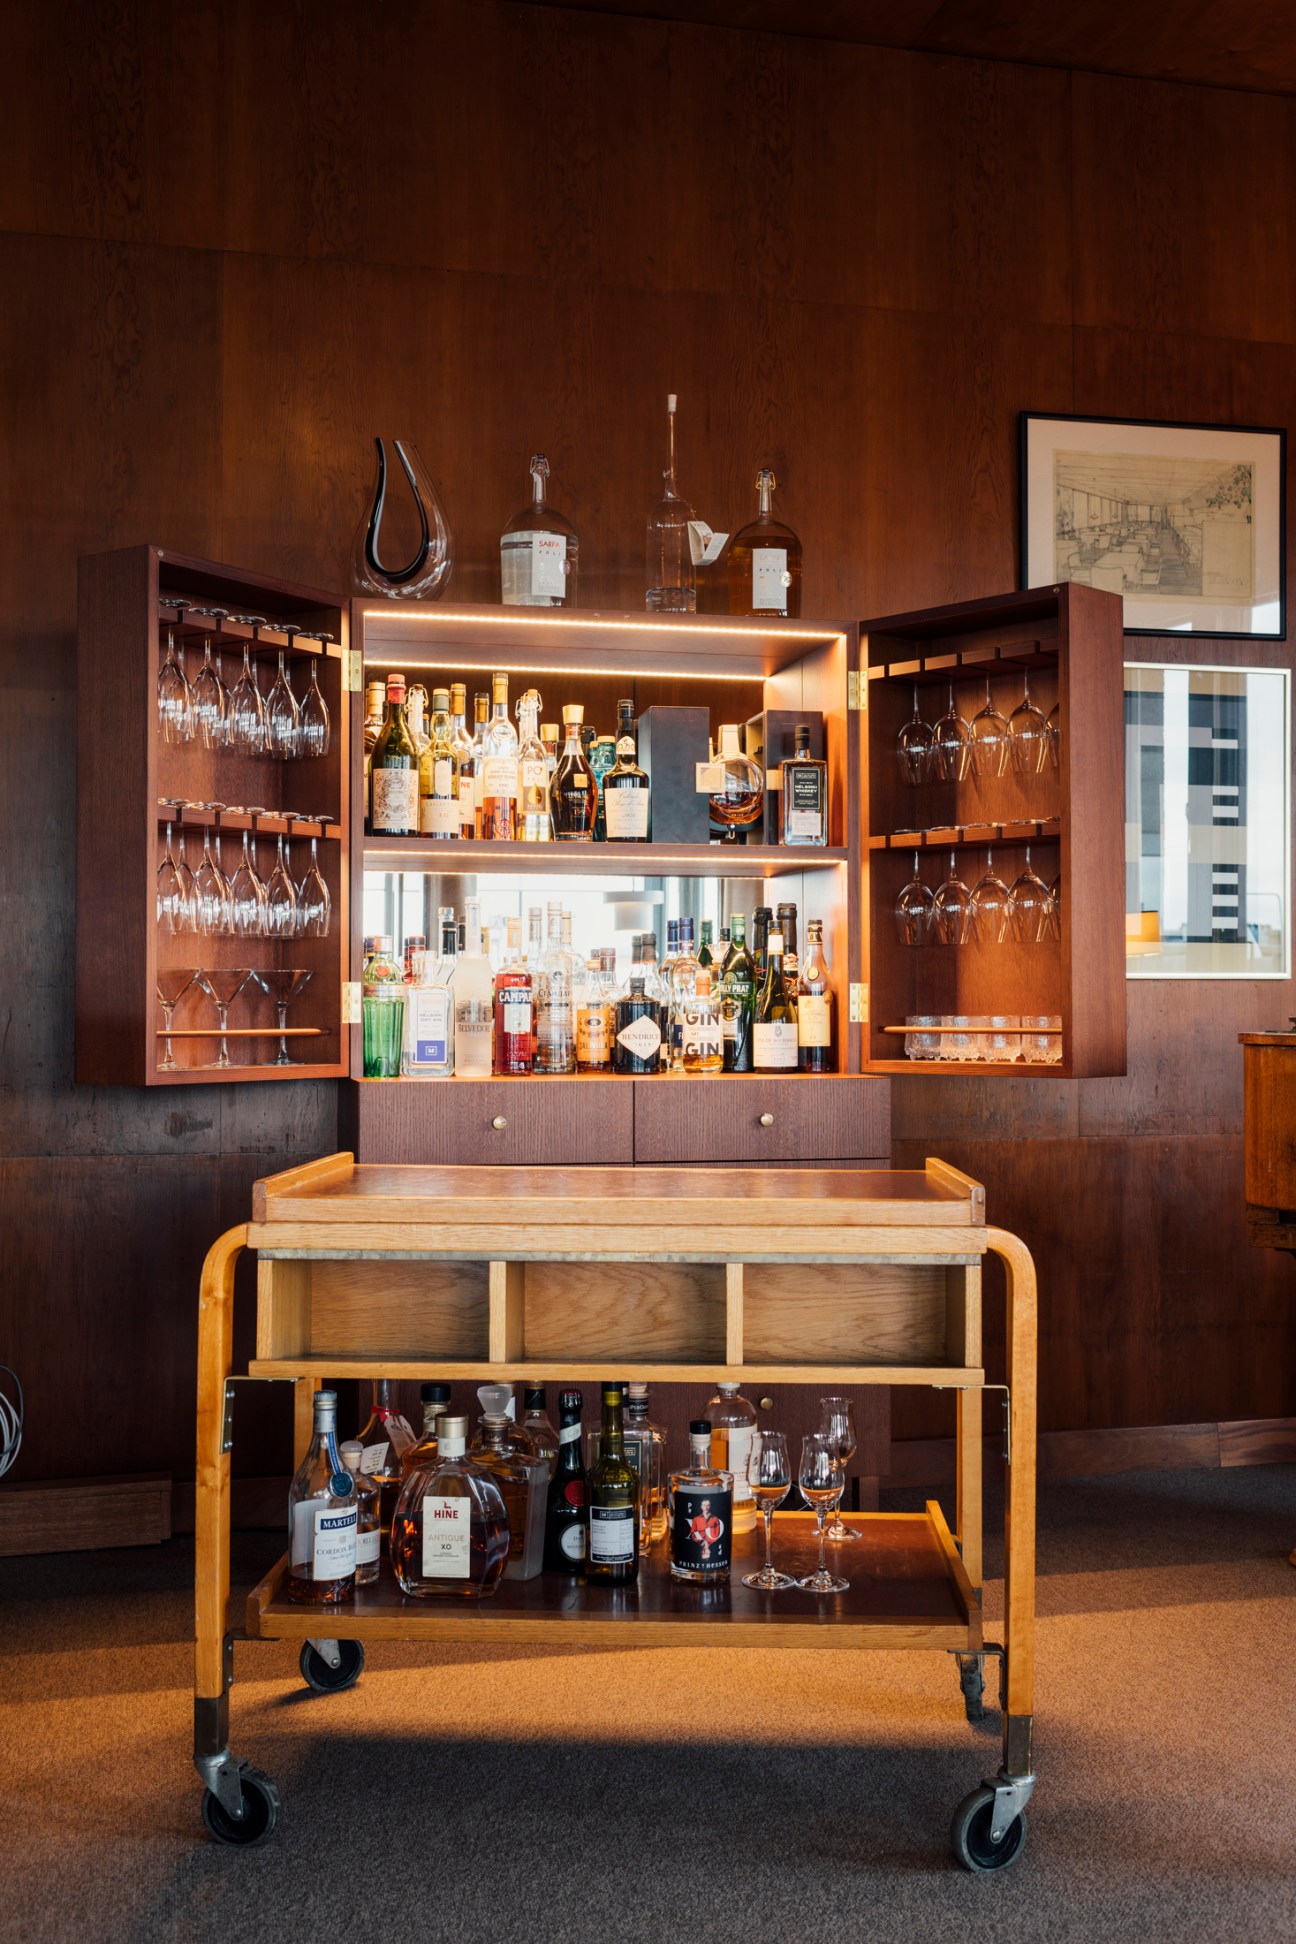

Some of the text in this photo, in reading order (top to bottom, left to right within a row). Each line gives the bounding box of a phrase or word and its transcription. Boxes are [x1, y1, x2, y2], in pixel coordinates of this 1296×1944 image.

[539, 540, 561, 549] SARPA
[732, 984, 750, 993] PRAT
[498, 991, 532, 1003] CAMPAR
[686, 1014, 720, 1026] GIN
[685, 1042, 720, 1055] GIN
[434, 1509, 459, 1519] HINE
[323, 1514, 356, 1528] MARTELL
[428, 1534, 465, 1542] ANTIQUE
[316, 1547, 347, 1556] CORDON
[678, 1560, 700, 1569] PRINZ
